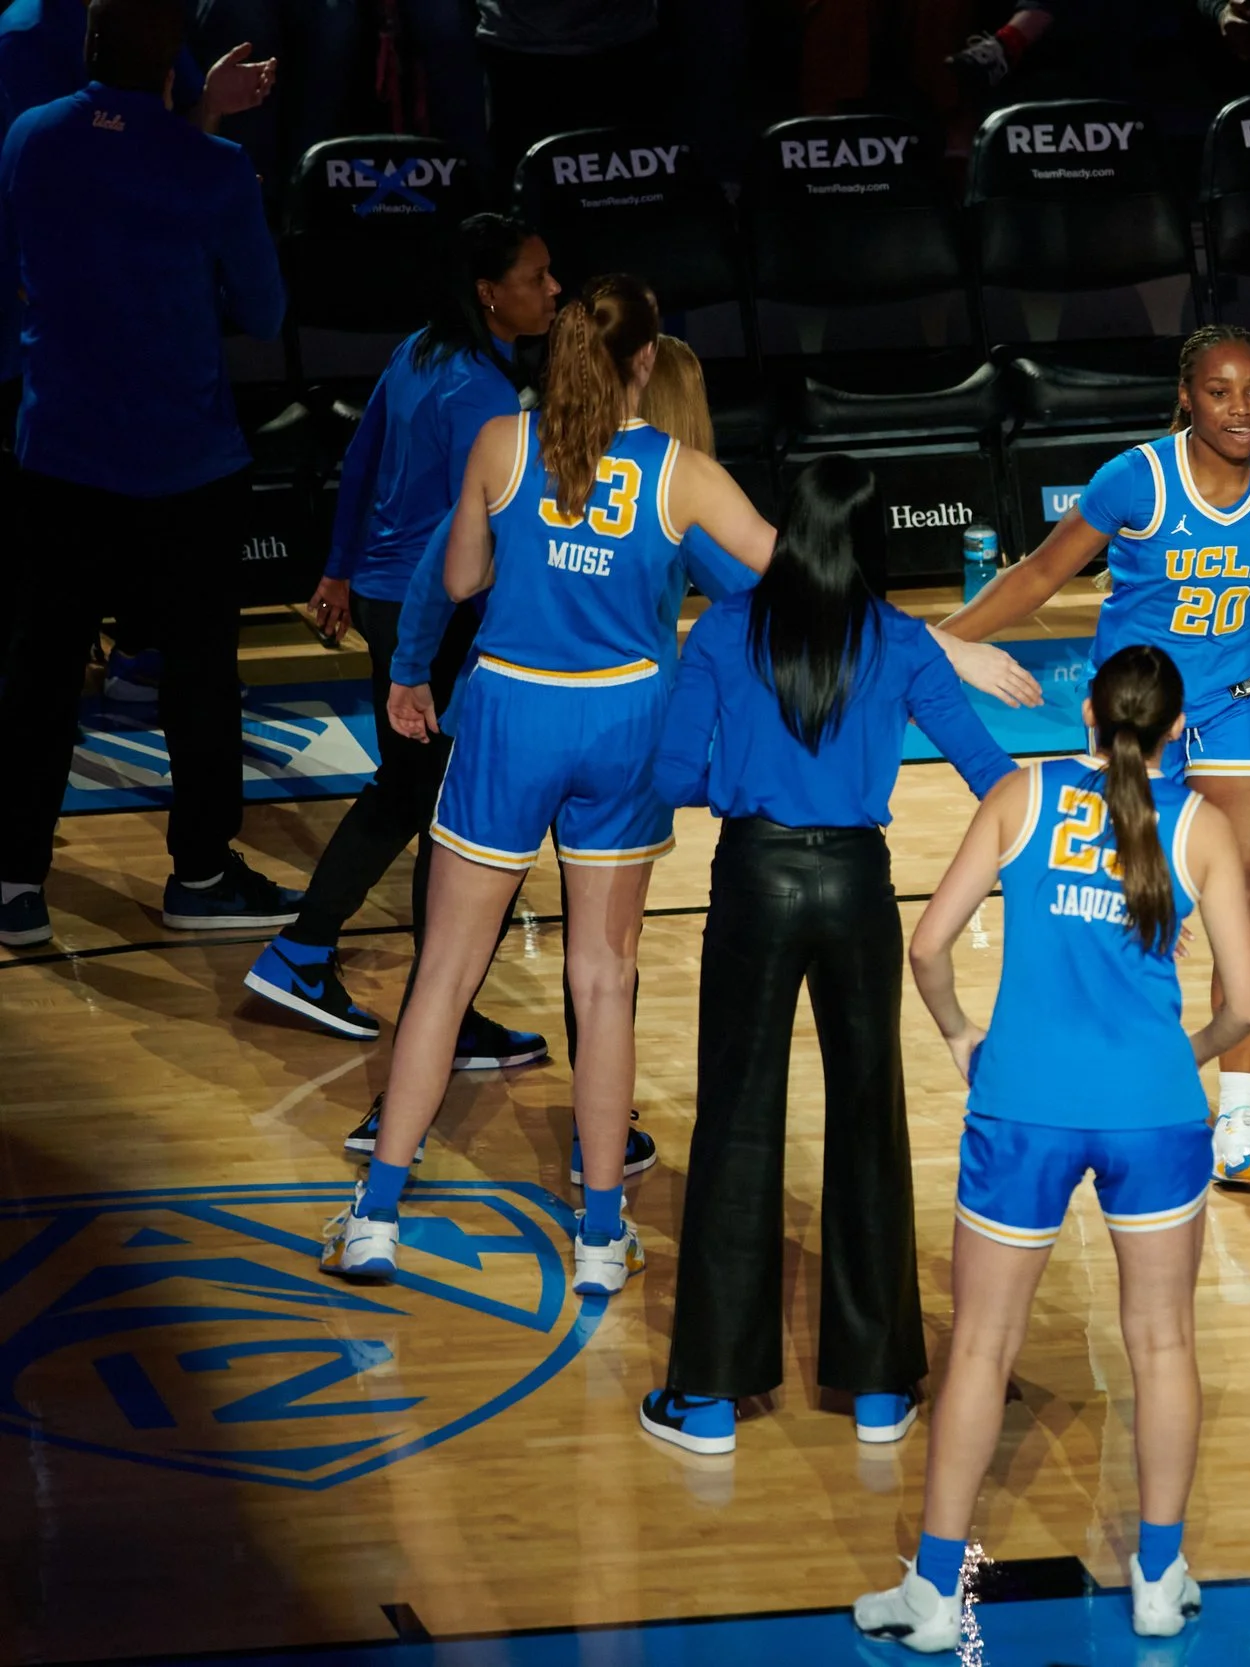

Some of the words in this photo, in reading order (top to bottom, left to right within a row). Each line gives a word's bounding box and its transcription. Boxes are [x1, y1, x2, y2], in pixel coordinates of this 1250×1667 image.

[780, 136, 908, 169] READY
[1006, 121, 1134, 154] READY
[326, 158, 457, 188] REDY
[552, 145, 680, 185] READY
[1031, 168, 1115, 180] TeamReady.com
[580, 193, 664, 208] TeamReady.com
[806, 182, 890, 194] TeamReady.com
[890, 502, 973, 529] Health
[241, 535, 289, 561] alth
[547, 539, 615, 577] MUSE
[1050, 883, 1135, 927] JAQUE
